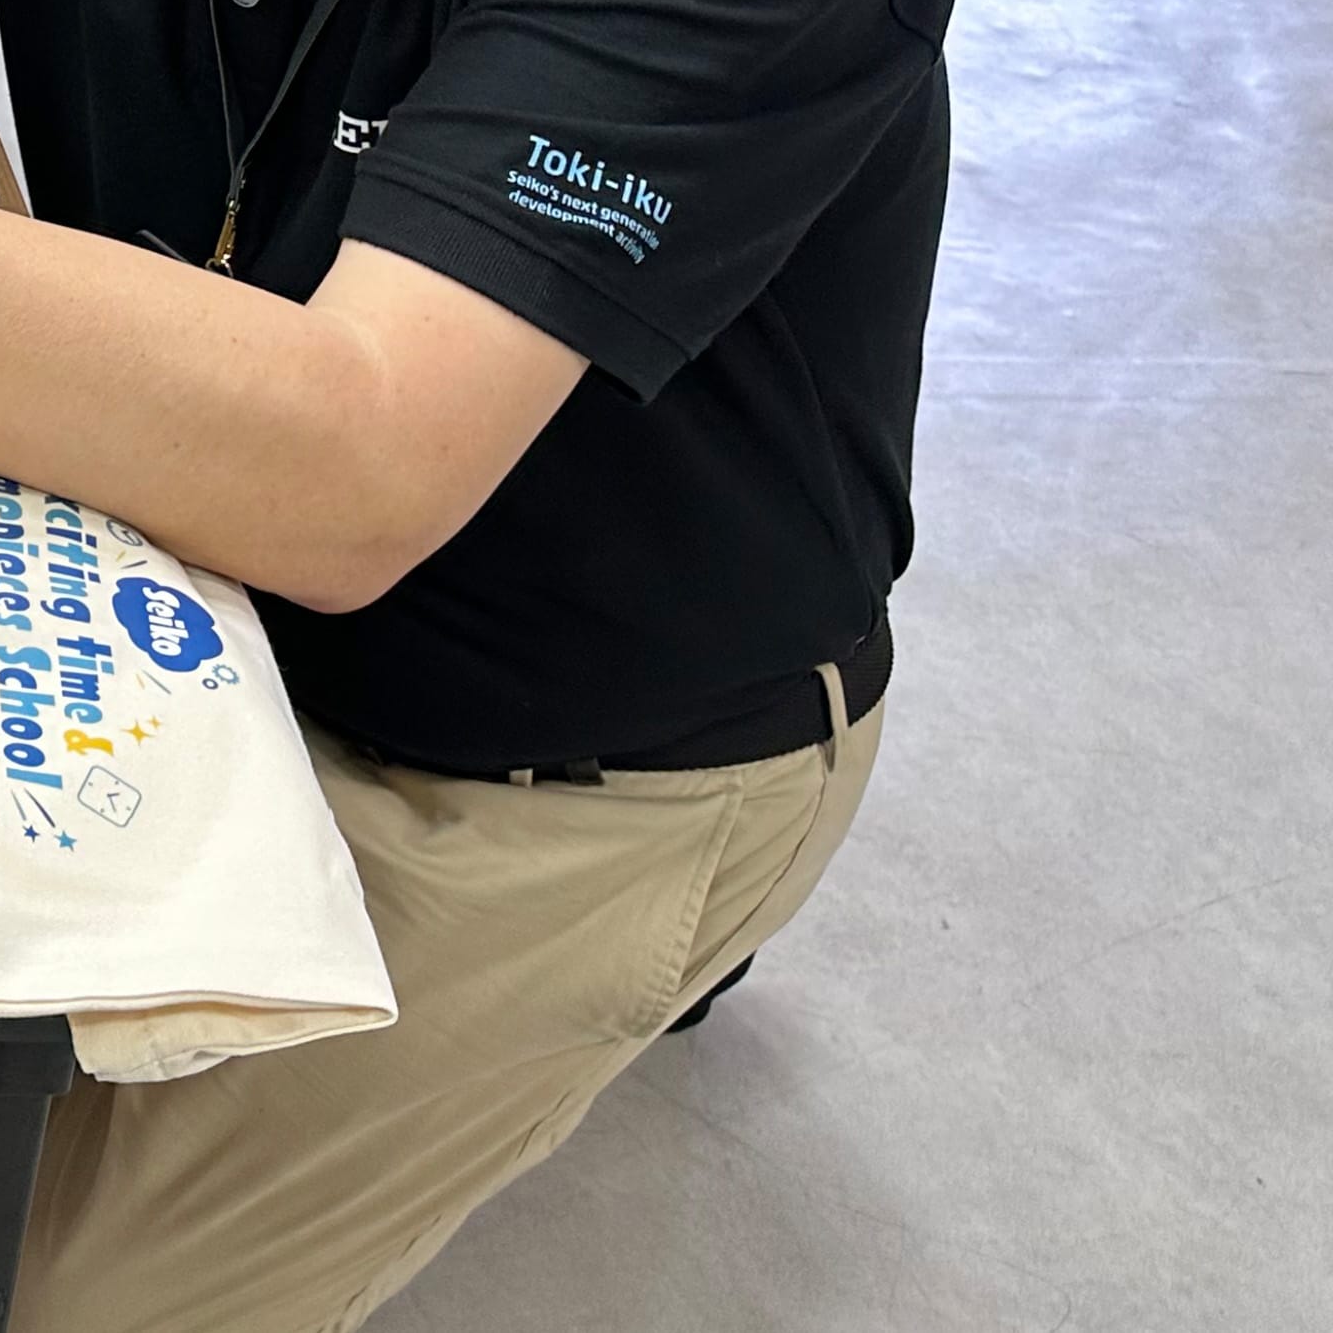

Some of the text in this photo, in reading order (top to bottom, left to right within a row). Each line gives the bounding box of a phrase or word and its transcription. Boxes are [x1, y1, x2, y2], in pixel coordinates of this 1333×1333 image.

[506, 169, 661, 251] Seiko's next generation
[527, 134, 673, 225] Toki-iku
[508, 189, 646, 265] development activity
[39, 495, 116, 758] xciting time &
[142, 586, 190, 657] Seiko
